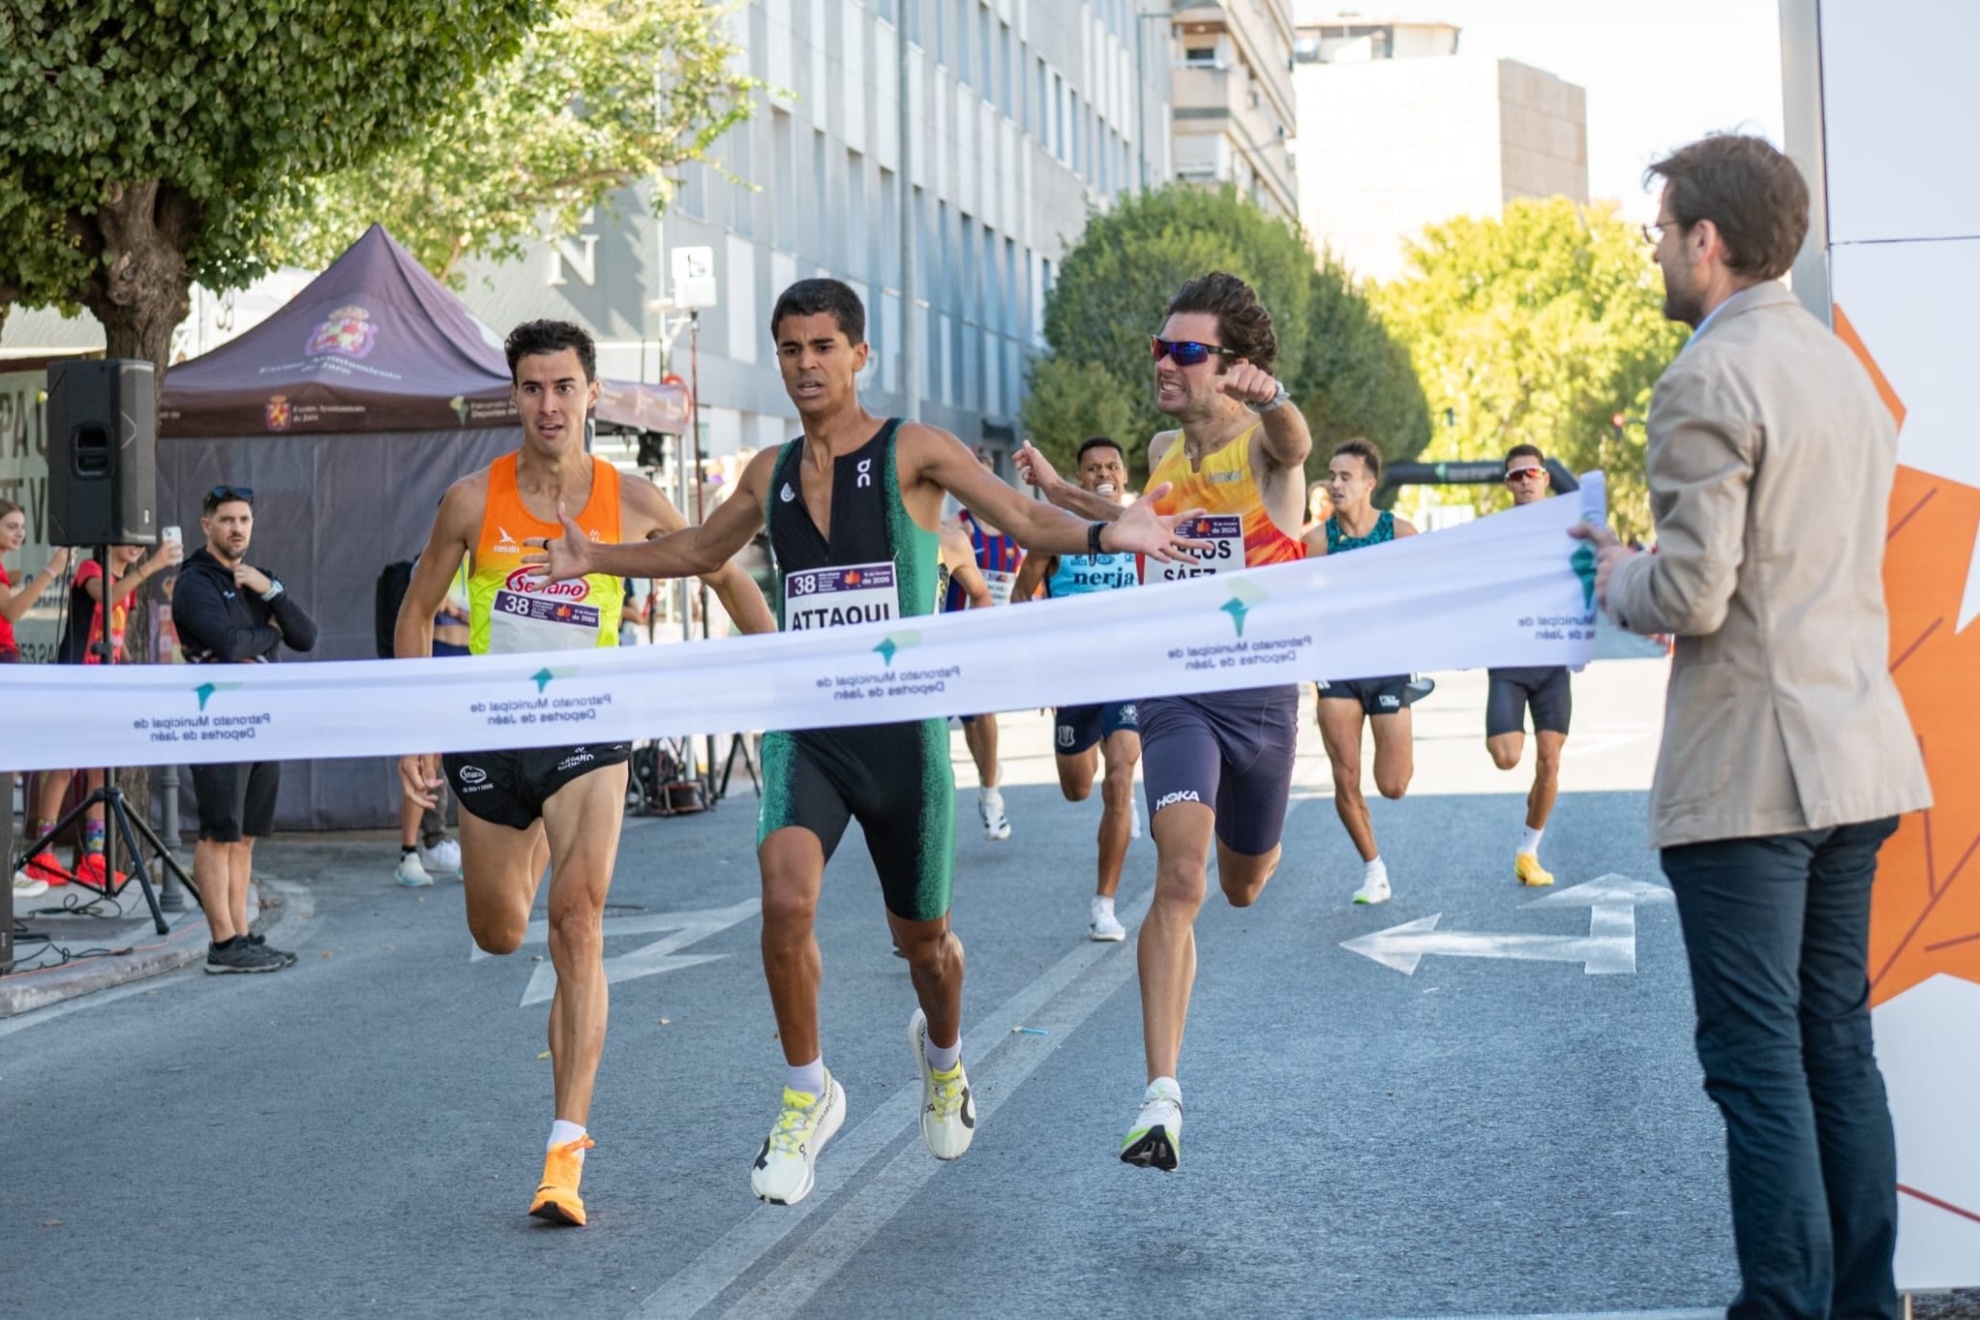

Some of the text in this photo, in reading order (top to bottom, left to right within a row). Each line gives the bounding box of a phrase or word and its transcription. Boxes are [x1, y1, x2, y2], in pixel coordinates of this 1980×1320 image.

[794, 574, 816, 595] 38
[1074, 566, 1135, 589] nerja
[505, 595, 529, 615] 38
[1156, 790, 1200, 811] HOKA
